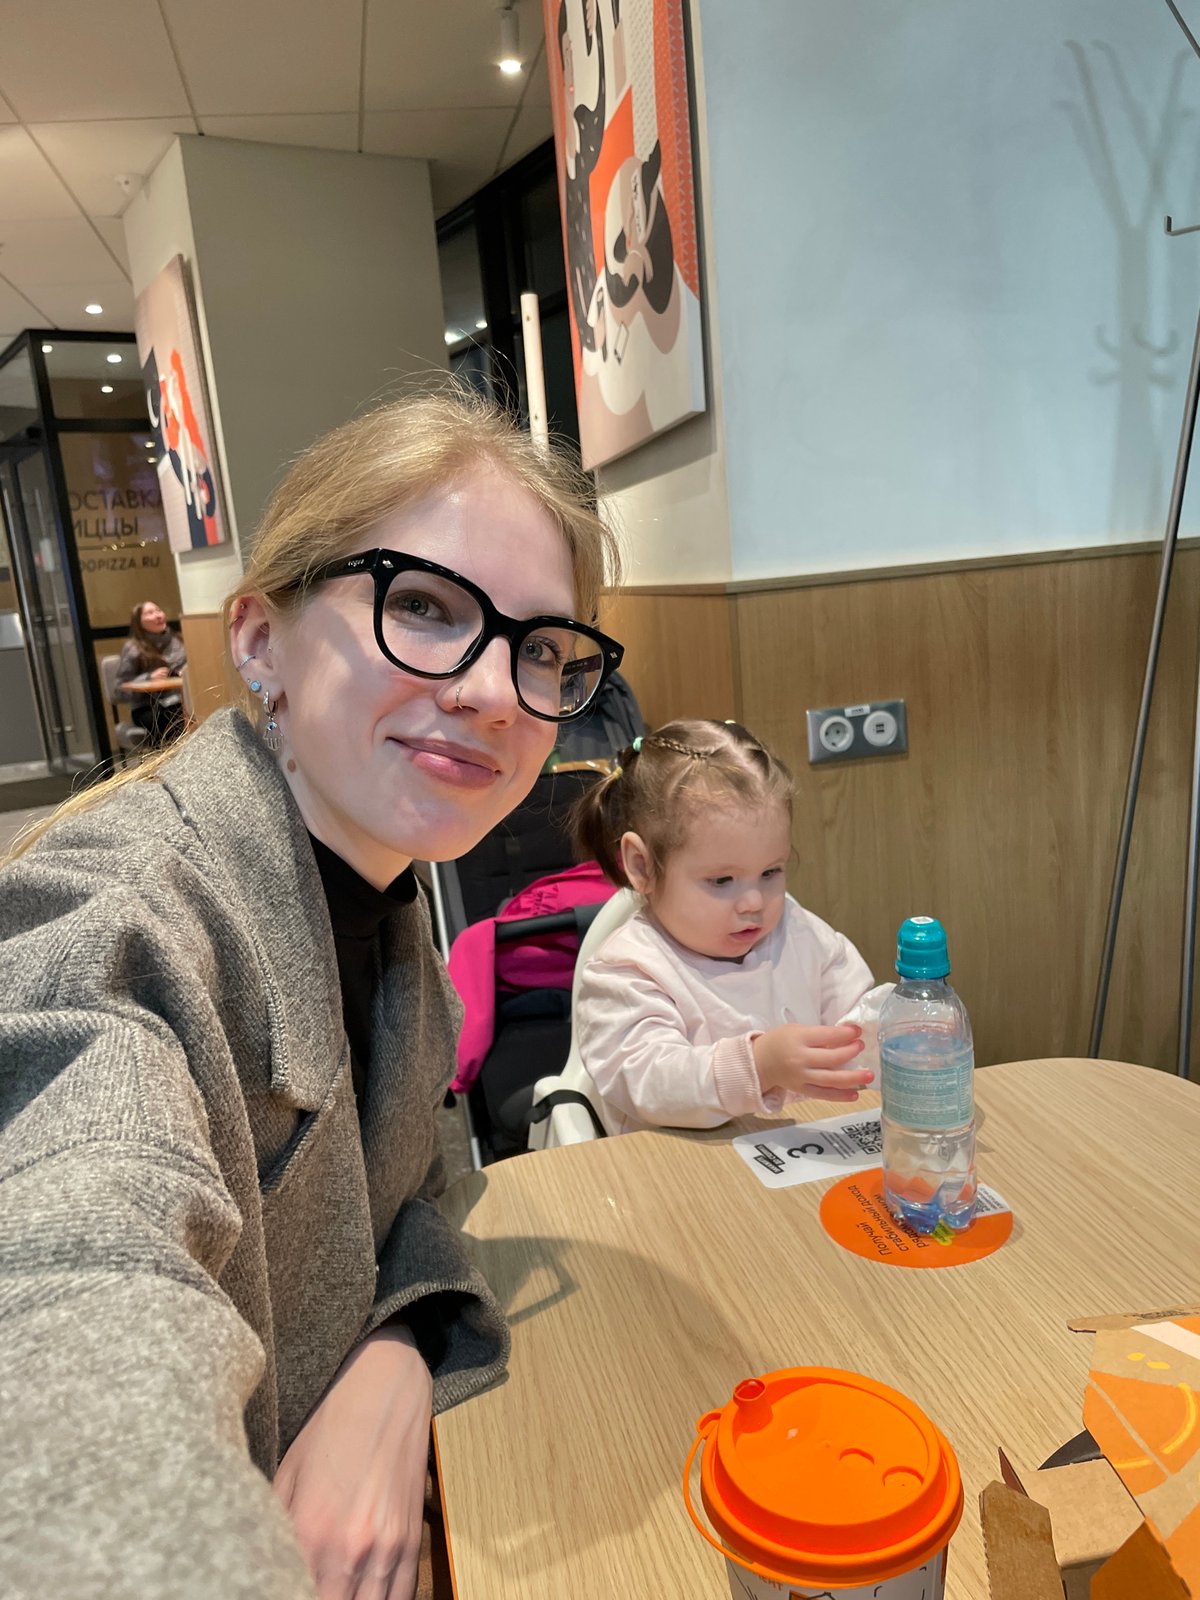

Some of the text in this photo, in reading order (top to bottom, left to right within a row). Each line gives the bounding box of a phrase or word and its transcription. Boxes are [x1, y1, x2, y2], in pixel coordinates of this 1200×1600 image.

[69, 489, 160, 511] ОСТАВК
[74, 518, 138, 540] ИЦЦЫ
[786, 1143, 825, 1159] 3
[848, 1184, 910, 1252] стабильный доход
[856, 1222, 893, 1256] Получай
